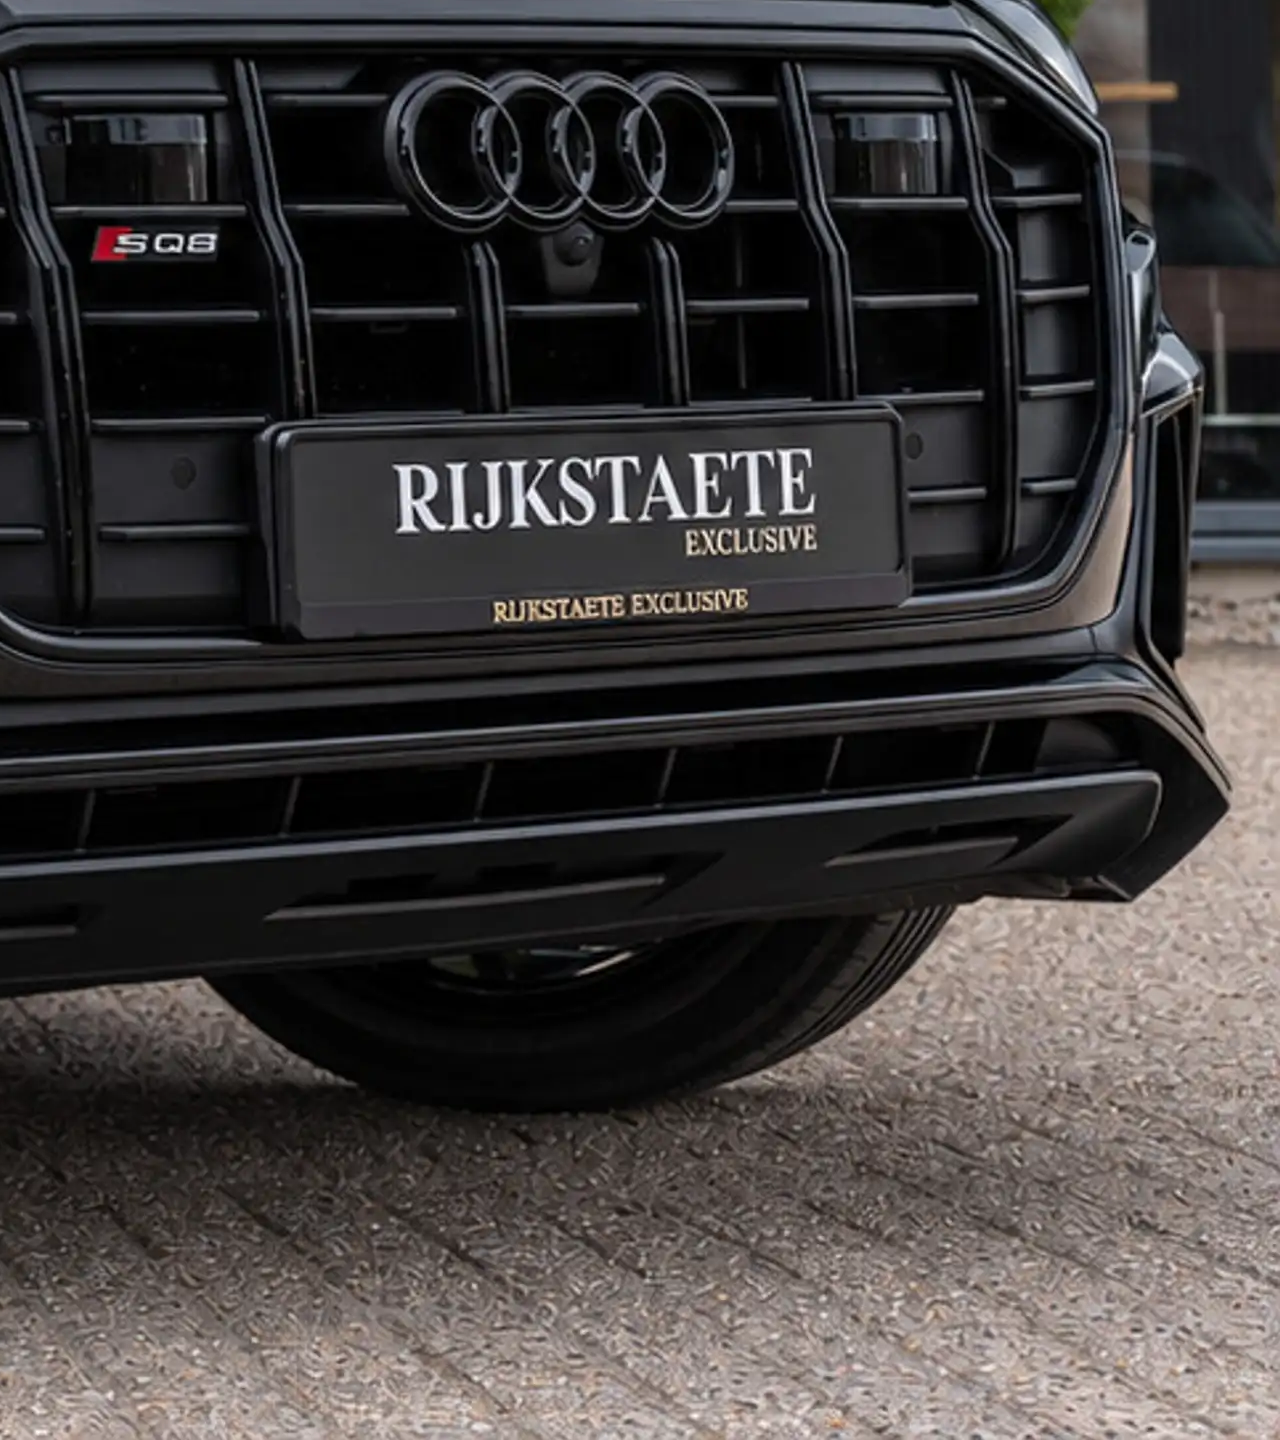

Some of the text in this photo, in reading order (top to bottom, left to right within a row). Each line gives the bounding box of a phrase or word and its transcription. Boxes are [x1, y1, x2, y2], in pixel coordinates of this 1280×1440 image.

[113, 232, 218, 254] SQ8
[392, 447, 817, 533] RIJKSTAETE
[684, 523, 818, 558] EXCLUSIVE
[492, 587, 750, 624] RIJKSTAETE EXCLUSIVE
